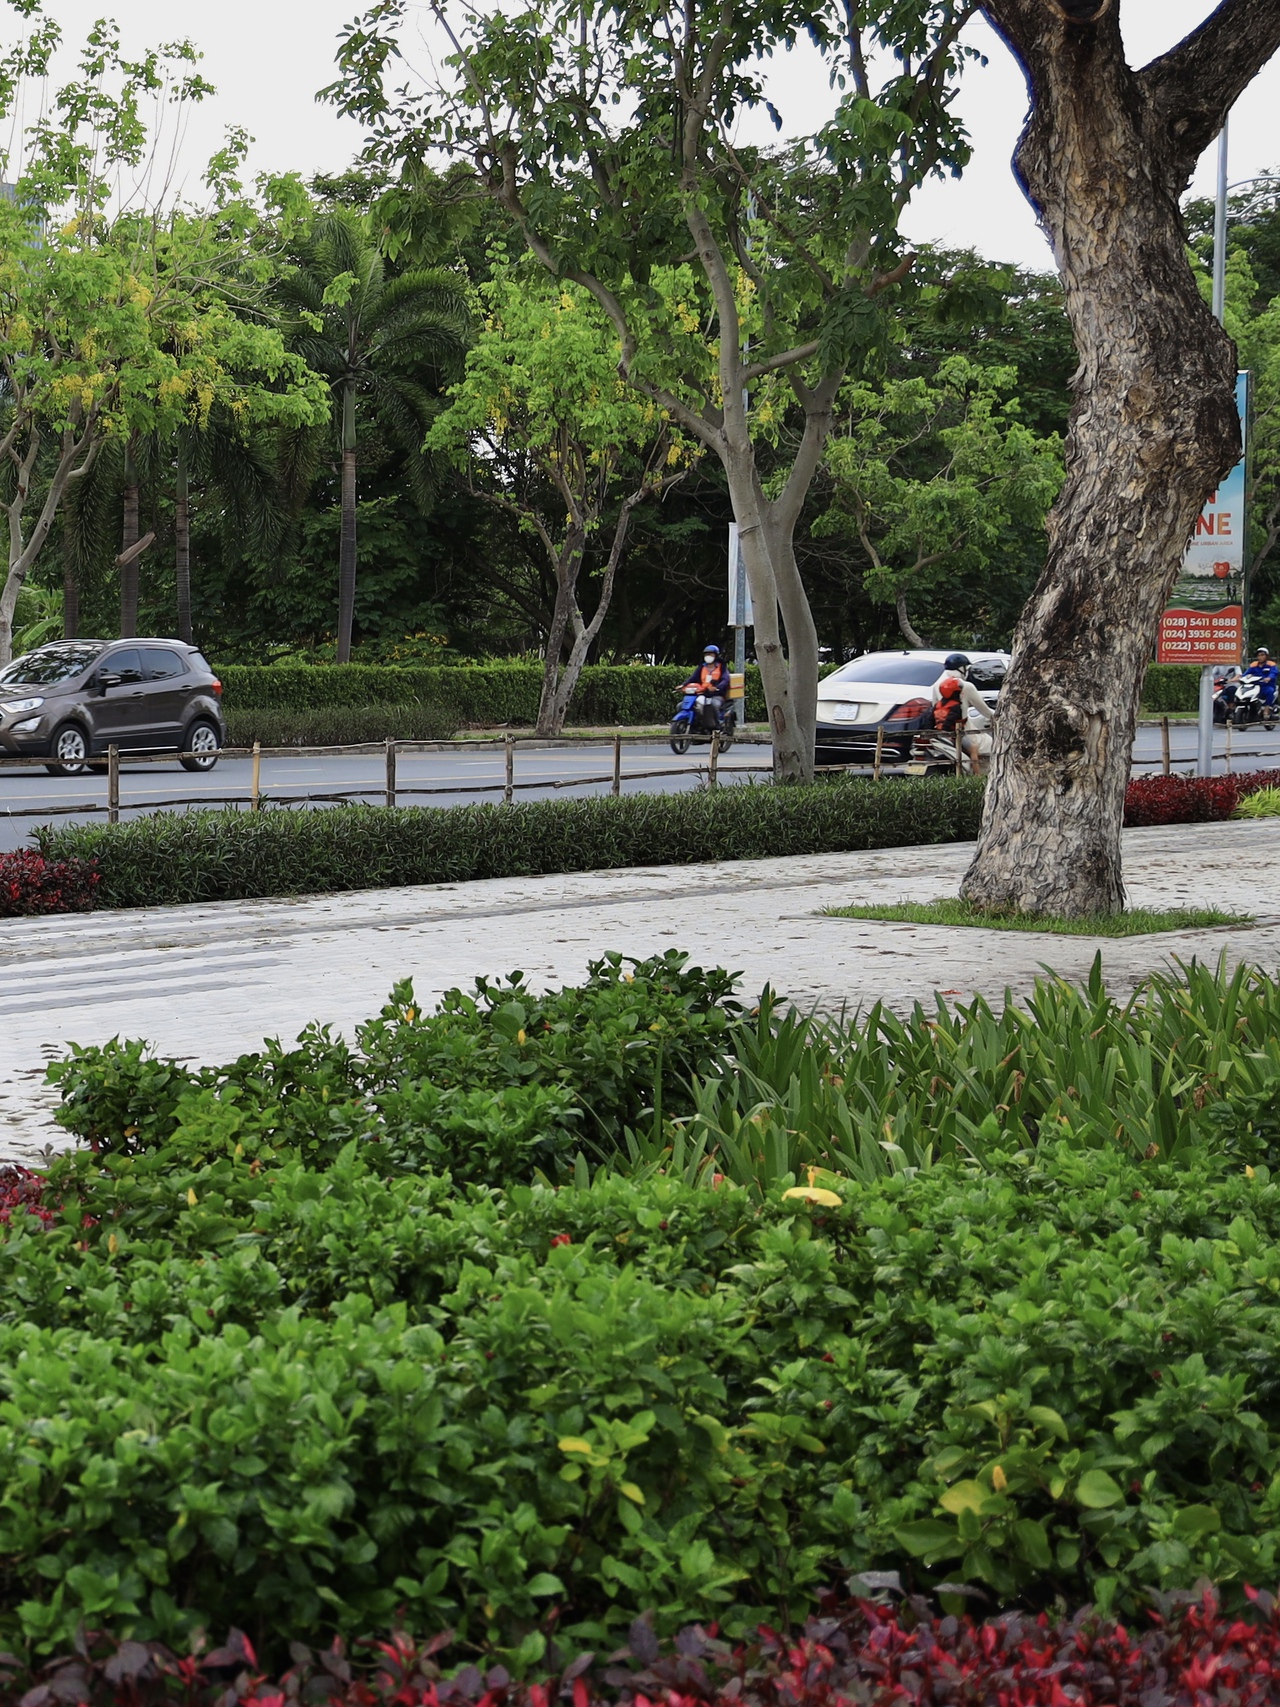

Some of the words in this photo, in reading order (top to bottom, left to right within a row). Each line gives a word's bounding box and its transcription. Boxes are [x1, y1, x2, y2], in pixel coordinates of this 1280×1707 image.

[1196, 513, 1232, 536] NE
[1162, 617, 1187, 628] (028)
[1190, 618, 1210, 626] 5411
[1212, 618, 1237, 627] 8888
[1162, 629, 1187, 640] (024)
[1188, 630, 1211, 638] 3936
[1212, 630, 1237, 639] 2640
[1162, 641, 1191, 652] (0222)
[1193, 642, 1215, 650] 3616
[1217, 642, 1237, 650] 888
